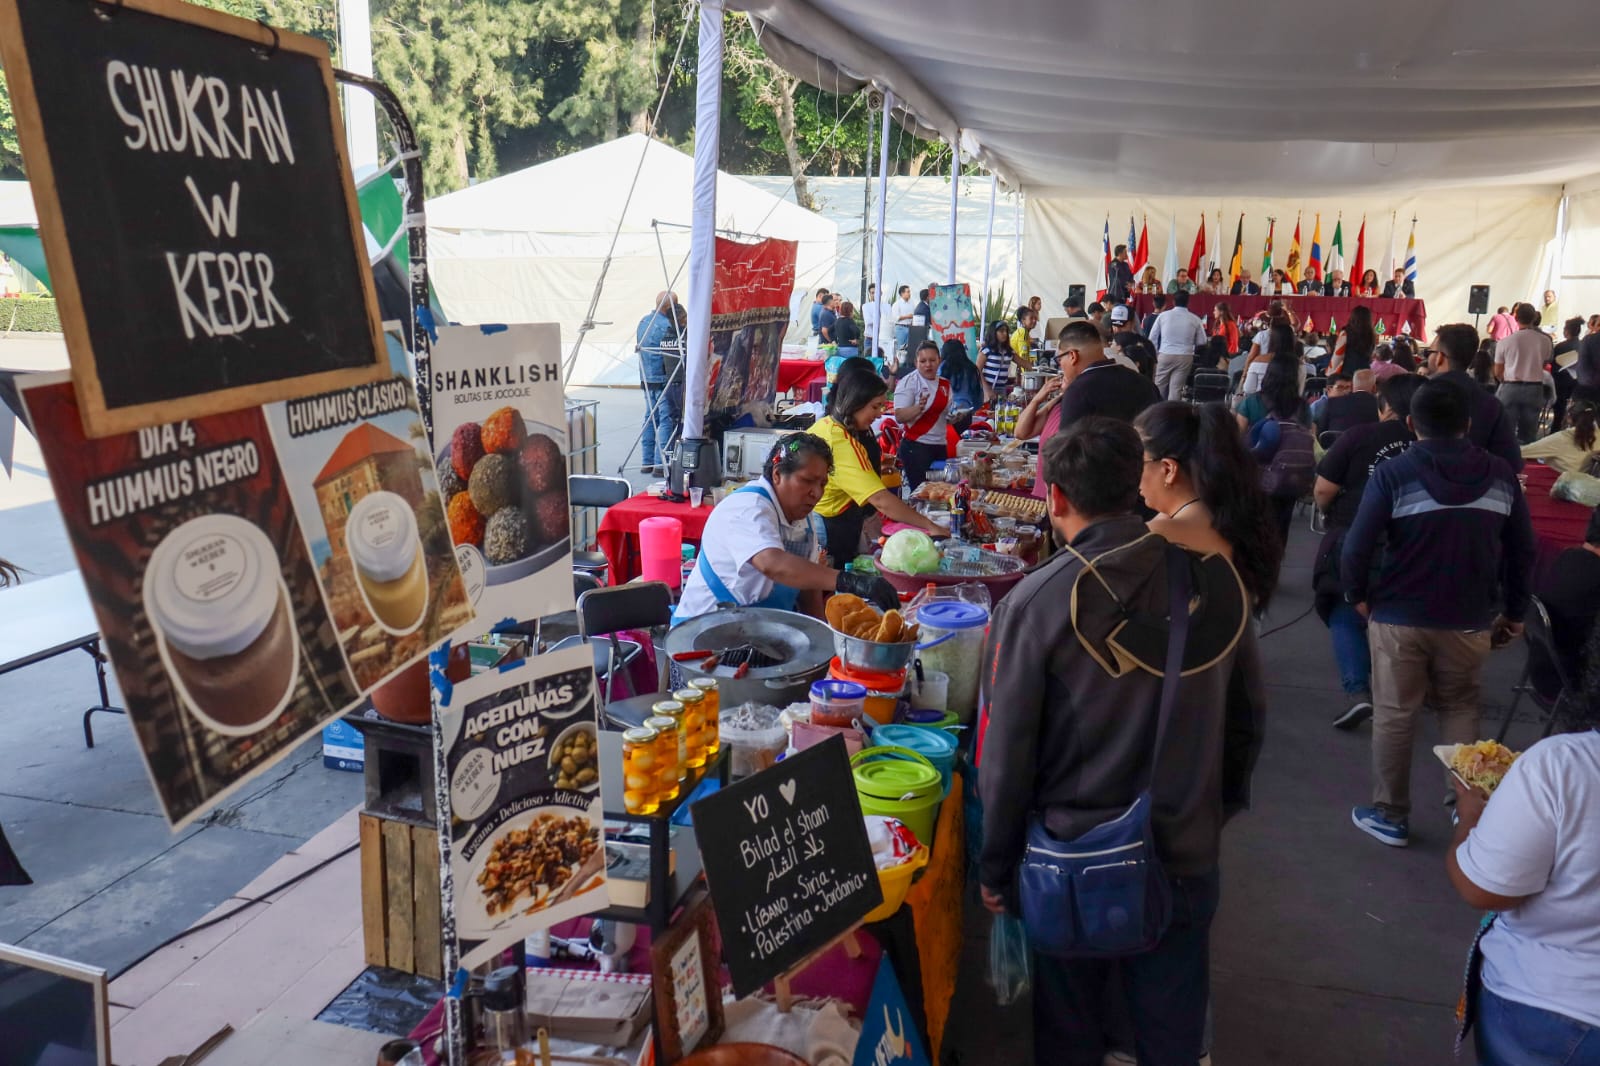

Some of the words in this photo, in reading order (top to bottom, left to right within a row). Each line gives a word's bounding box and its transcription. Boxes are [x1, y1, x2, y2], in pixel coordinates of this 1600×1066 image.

[106, 60, 294, 164] SHUKRAN
[185, 175, 240, 238] W
[166, 251, 290, 340] KEBER
[435, 363, 558, 392] SHANKLISH
[483, 390, 492, 400] DE
[494, 387, 531, 400] JOCOQUE
[180, 420, 196, 447] 4
[289, 392, 356, 434] HUMMUS
[87, 460, 194, 526] HUMMUS
[195, 441, 259, 491] NEGRO
[464, 684, 574, 740] ACEITUNAS
[496, 717, 539, 747] CON
[494, 738, 546, 774] NUEZ
[462, 822, 494, 859] Vegano
[499, 796, 544, 821] Delicioso
[744, 794, 768, 824] YO
[740, 825, 780, 868] Bilad
[784, 817, 796, 845] el
[804, 833, 824, 860] بلاد
[766, 845, 798, 894] الشام
[798, 870, 830, 900] Siria
[756, 909, 814, 960] Palestina
[816, 872, 864, 912] Jordania
